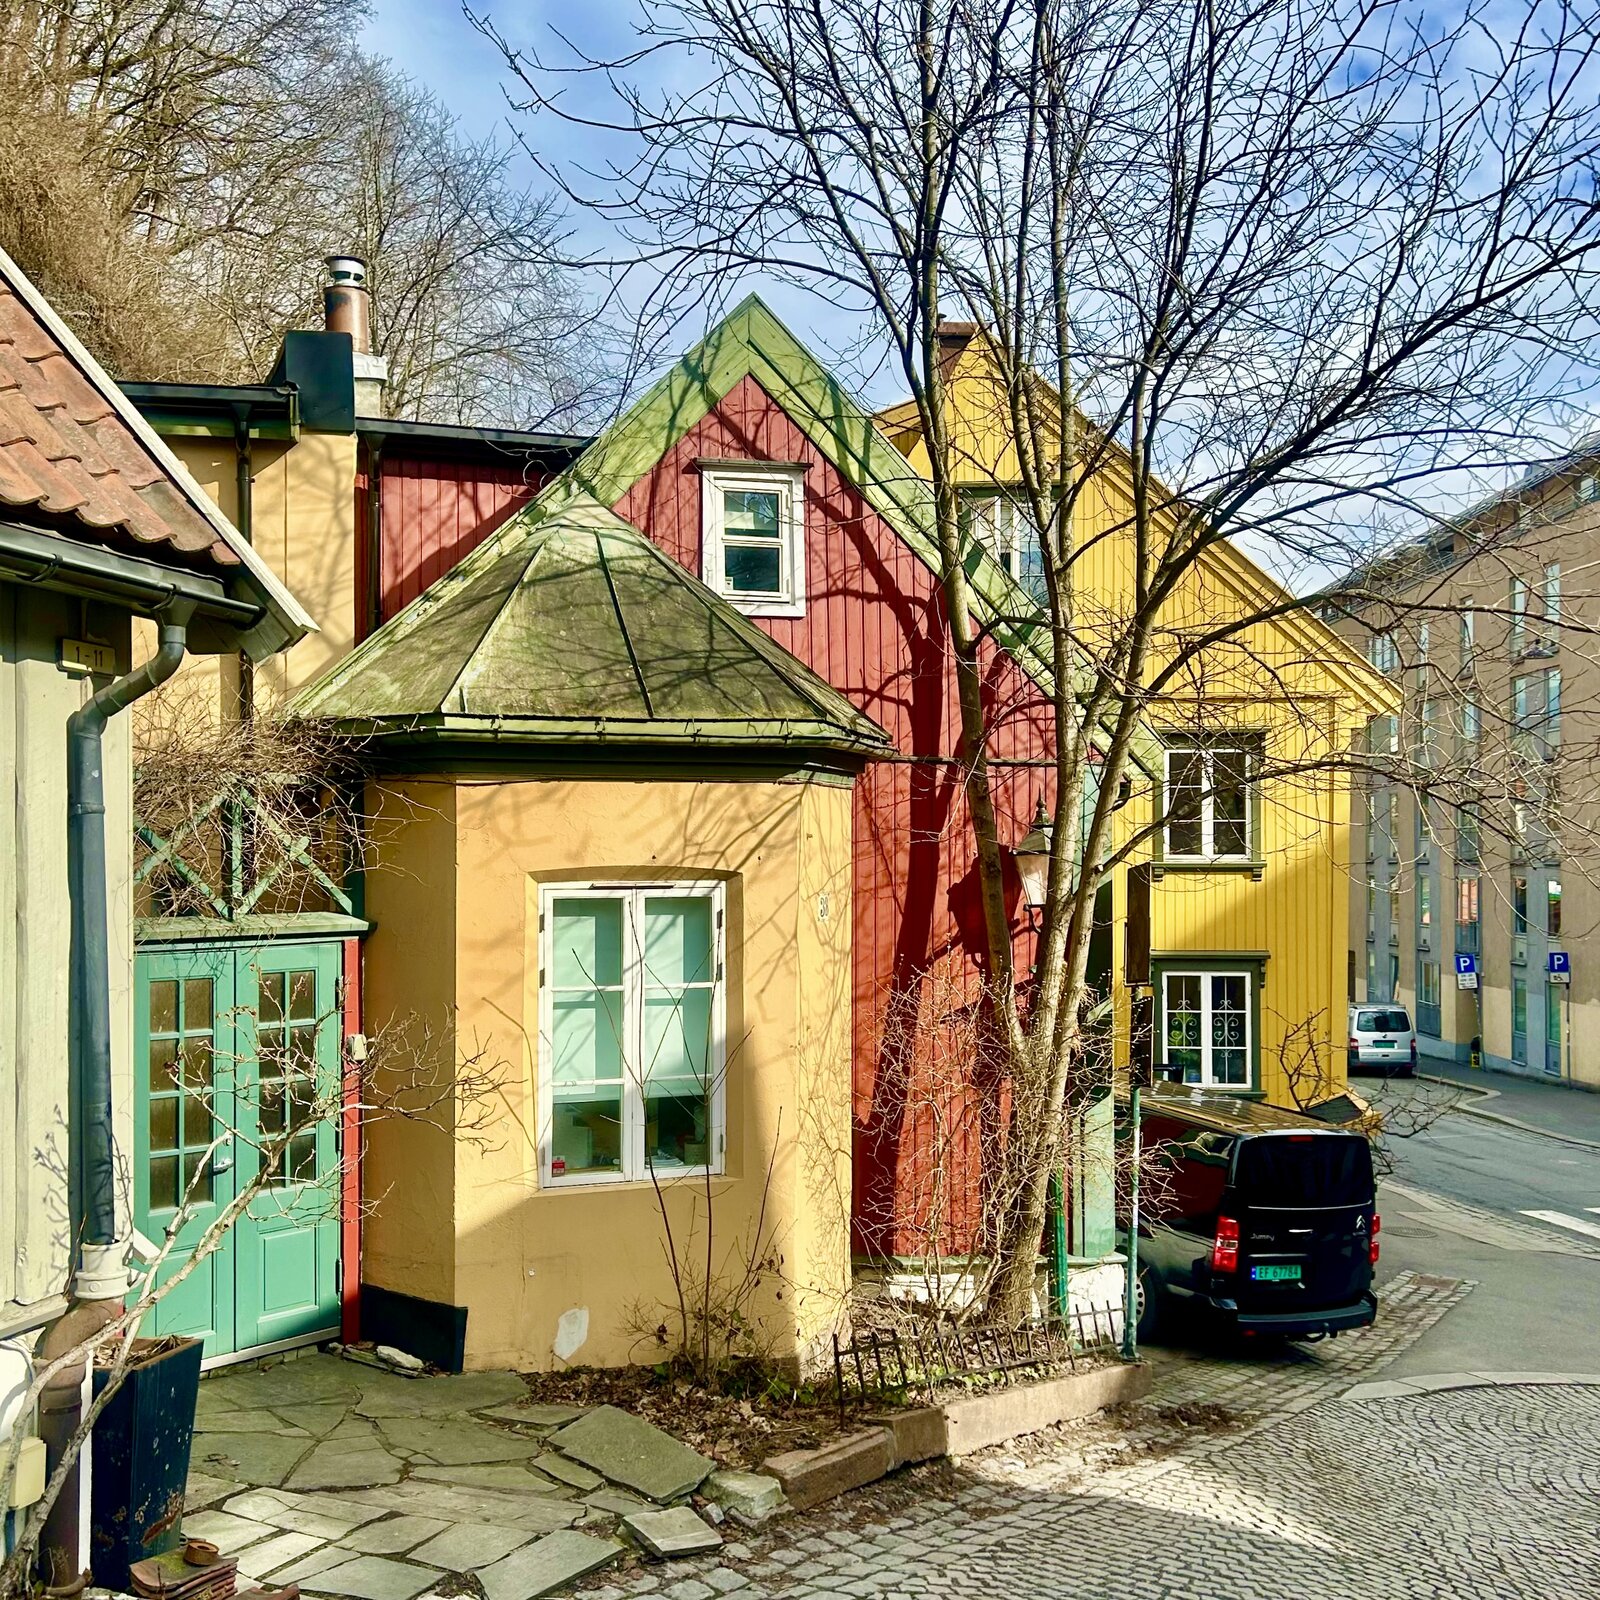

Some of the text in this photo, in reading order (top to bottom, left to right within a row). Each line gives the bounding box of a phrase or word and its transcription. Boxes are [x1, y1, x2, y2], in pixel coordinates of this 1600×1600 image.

[1459, 957, 1470, 971] P
[1554, 955, 1564, 970] P
[1259, 1266, 1298, 1278] EF 67784
